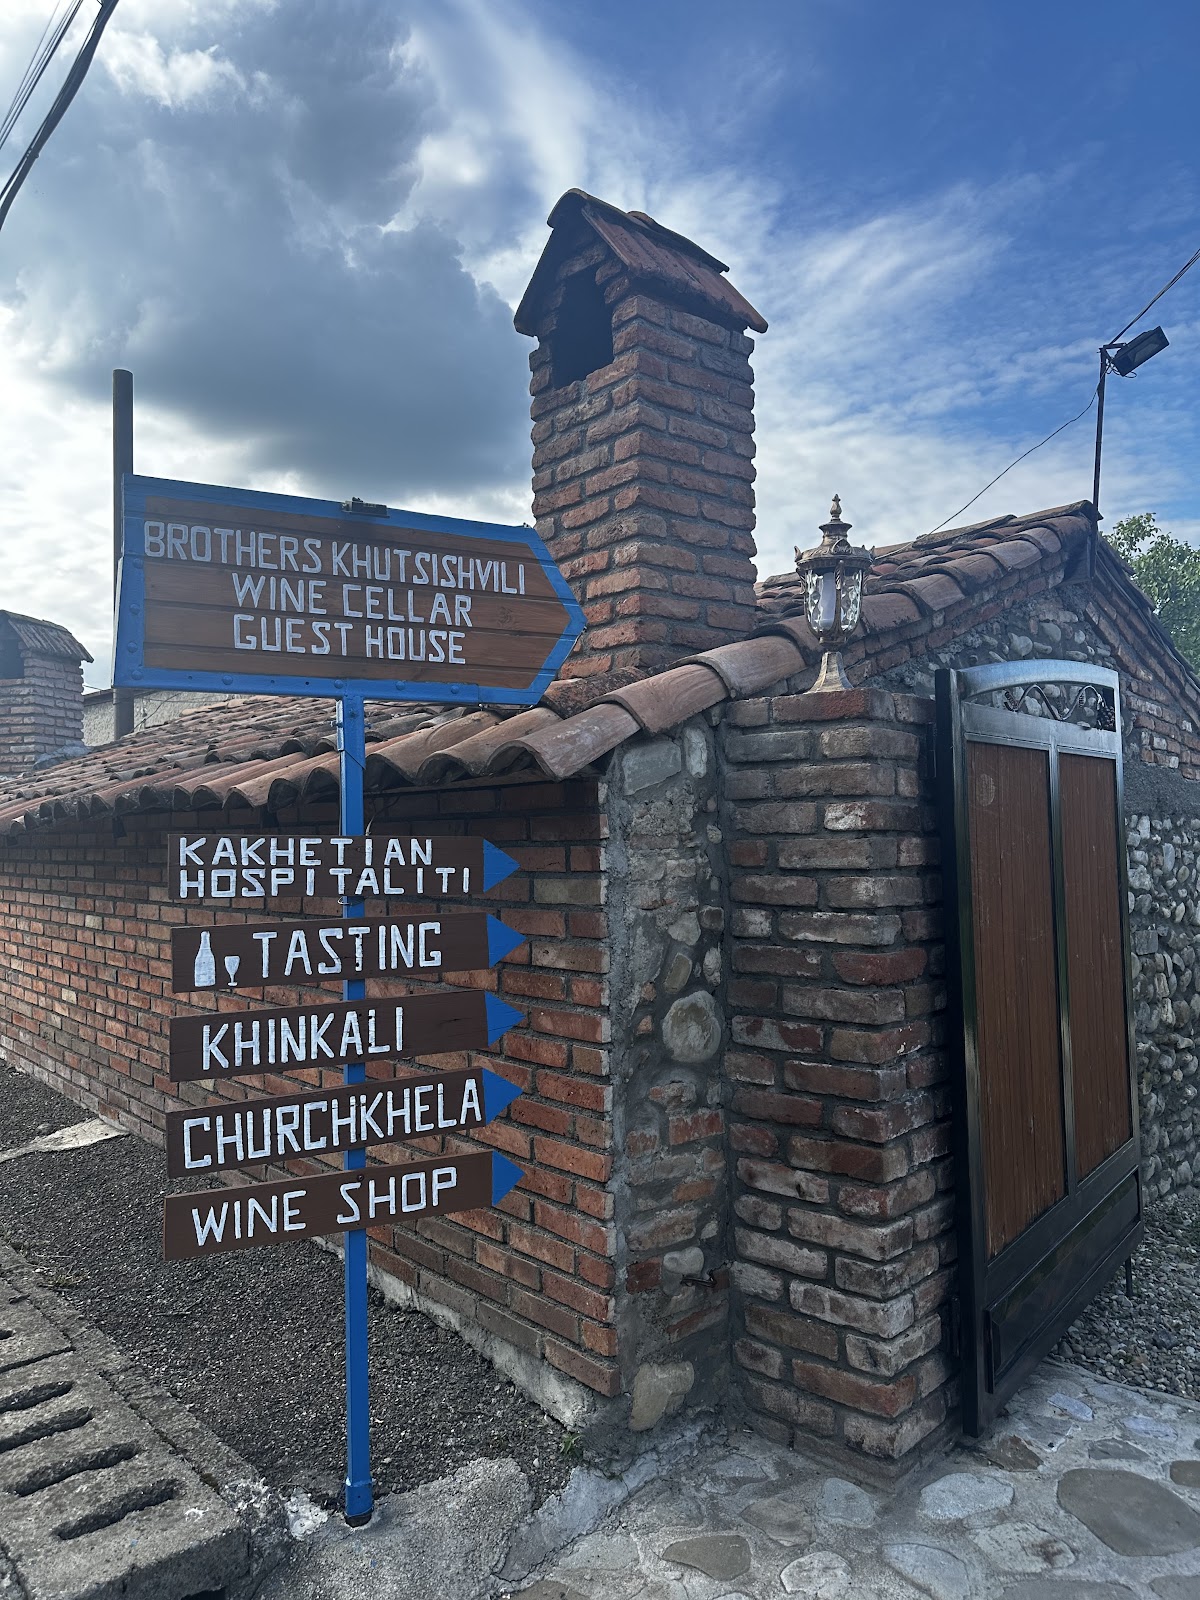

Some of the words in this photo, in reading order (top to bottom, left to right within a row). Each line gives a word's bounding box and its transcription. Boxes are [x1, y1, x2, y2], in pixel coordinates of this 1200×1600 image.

[144, 521, 322, 573] BROTHERS
[332, 541, 526, 595] KHUTSISHVILI
[233, 574, 327, 614] WINE
[343, 584, 473, 626] CELLAR
[234, 615, 353, 656] GUEST
[366, 627, 466, 664] HOUSE
[179, 837, 433, 867] KAKHETIAN
[179, 868, 470, 898] HOSPITALITI
[252, 921, 442, 979] TASTING
[202, 1006, 403, 1071] KHINKALI
[183, 1078, 482, 1169] CHURCHKHELA
[191, 1190, 307, 1247] WINE
[336, 1166, 458, 1225] SHOP
